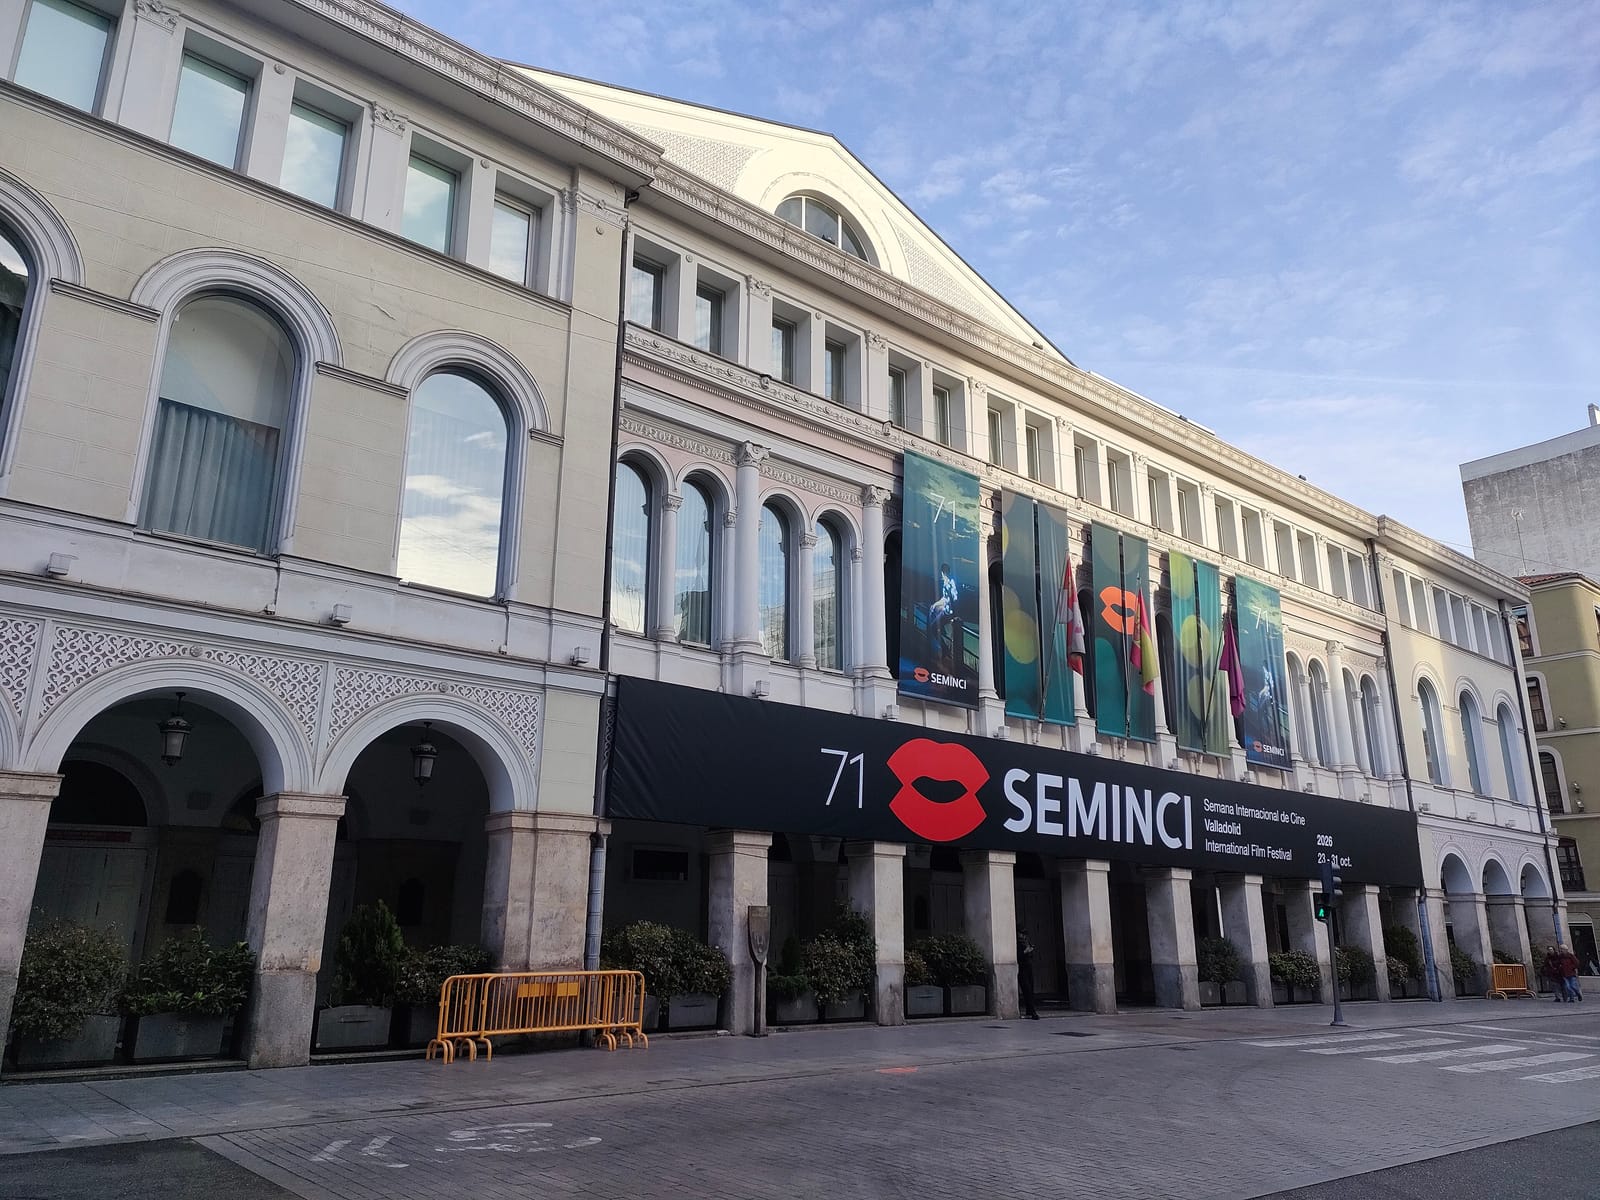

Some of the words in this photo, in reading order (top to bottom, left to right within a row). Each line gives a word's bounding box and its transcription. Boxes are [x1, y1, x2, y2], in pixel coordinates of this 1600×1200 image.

[930, 492, 956, 530] 71
[1252, 605, 1269, 633] 71
[930, 672, 967, 690] SEMINCI
[1263, 744, 1285, 757] SEMINCI
[820, 748, 864, 809] 71
[1003, 769, 1193, 850] SEMINCI
[1203, 798, 1235, 815] Semana
[1235, 803, 1280, 822] Internacional
[1280, 811, 1290, 824] de
[1290, 812, 1306, 826] Cine
[1204, 818, 1242, 836] Valladolid
[1205, 838, 1250, 856] International
[1251, 844, 1266, 858] Film
[1267, 846, 1293, 861] Festival
[1317, 834, 1333, 847] 2026
[1317, 852, 1326, 864] 23
[1331, 853, 1338, 865] 31
[1340, 856, 1353, 867] oct.
